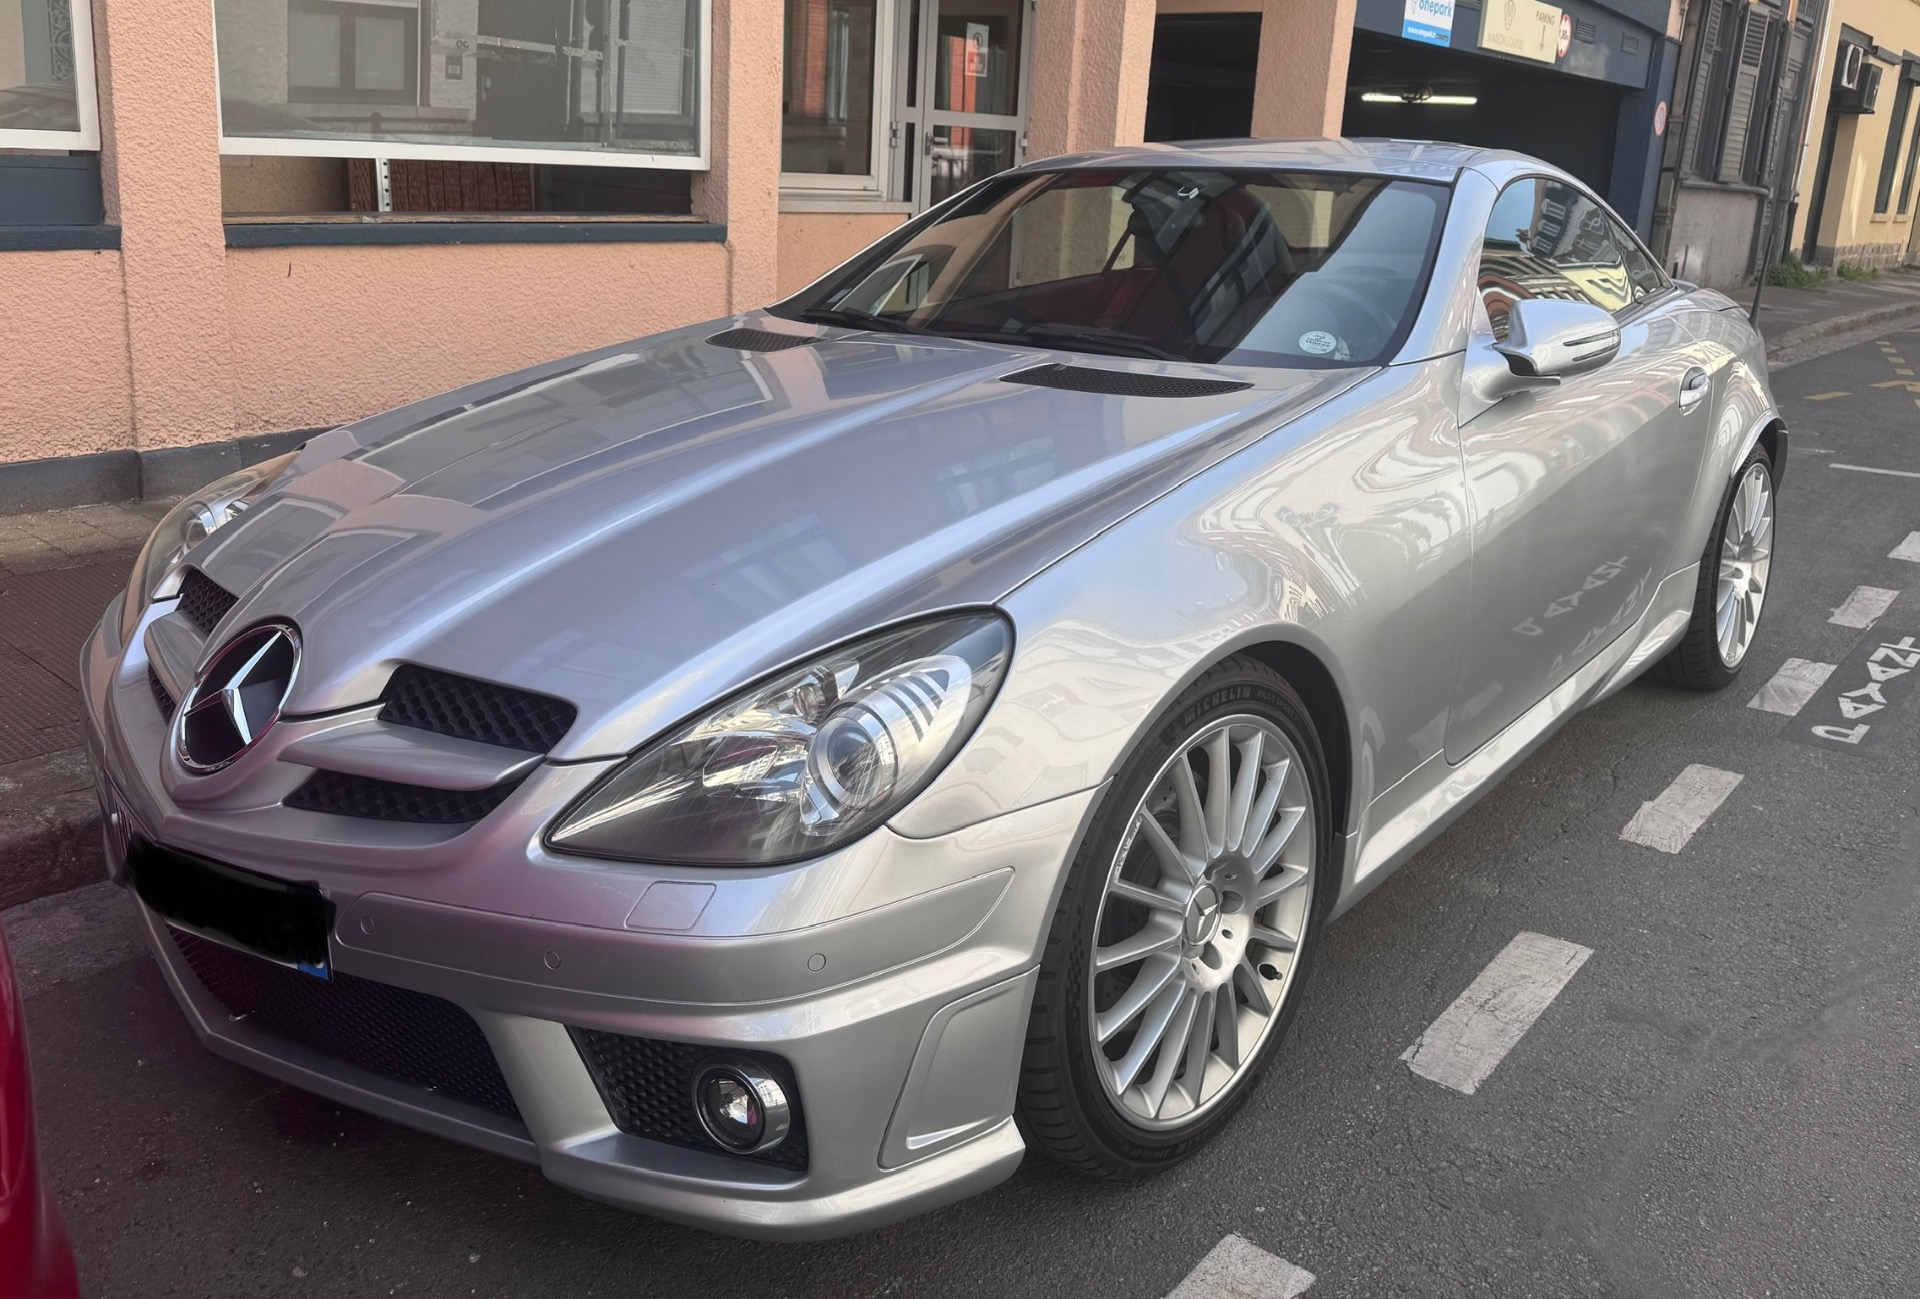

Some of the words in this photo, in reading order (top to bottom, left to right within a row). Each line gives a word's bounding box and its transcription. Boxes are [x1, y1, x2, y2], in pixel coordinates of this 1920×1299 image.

[1419, 0, 1453, 18] onepark
[1536, 10, 1556, 26] PARKING
[1811, 636, 1920, 745] PAYANT
[1184, 686, 1252, 725] MICHELIN
